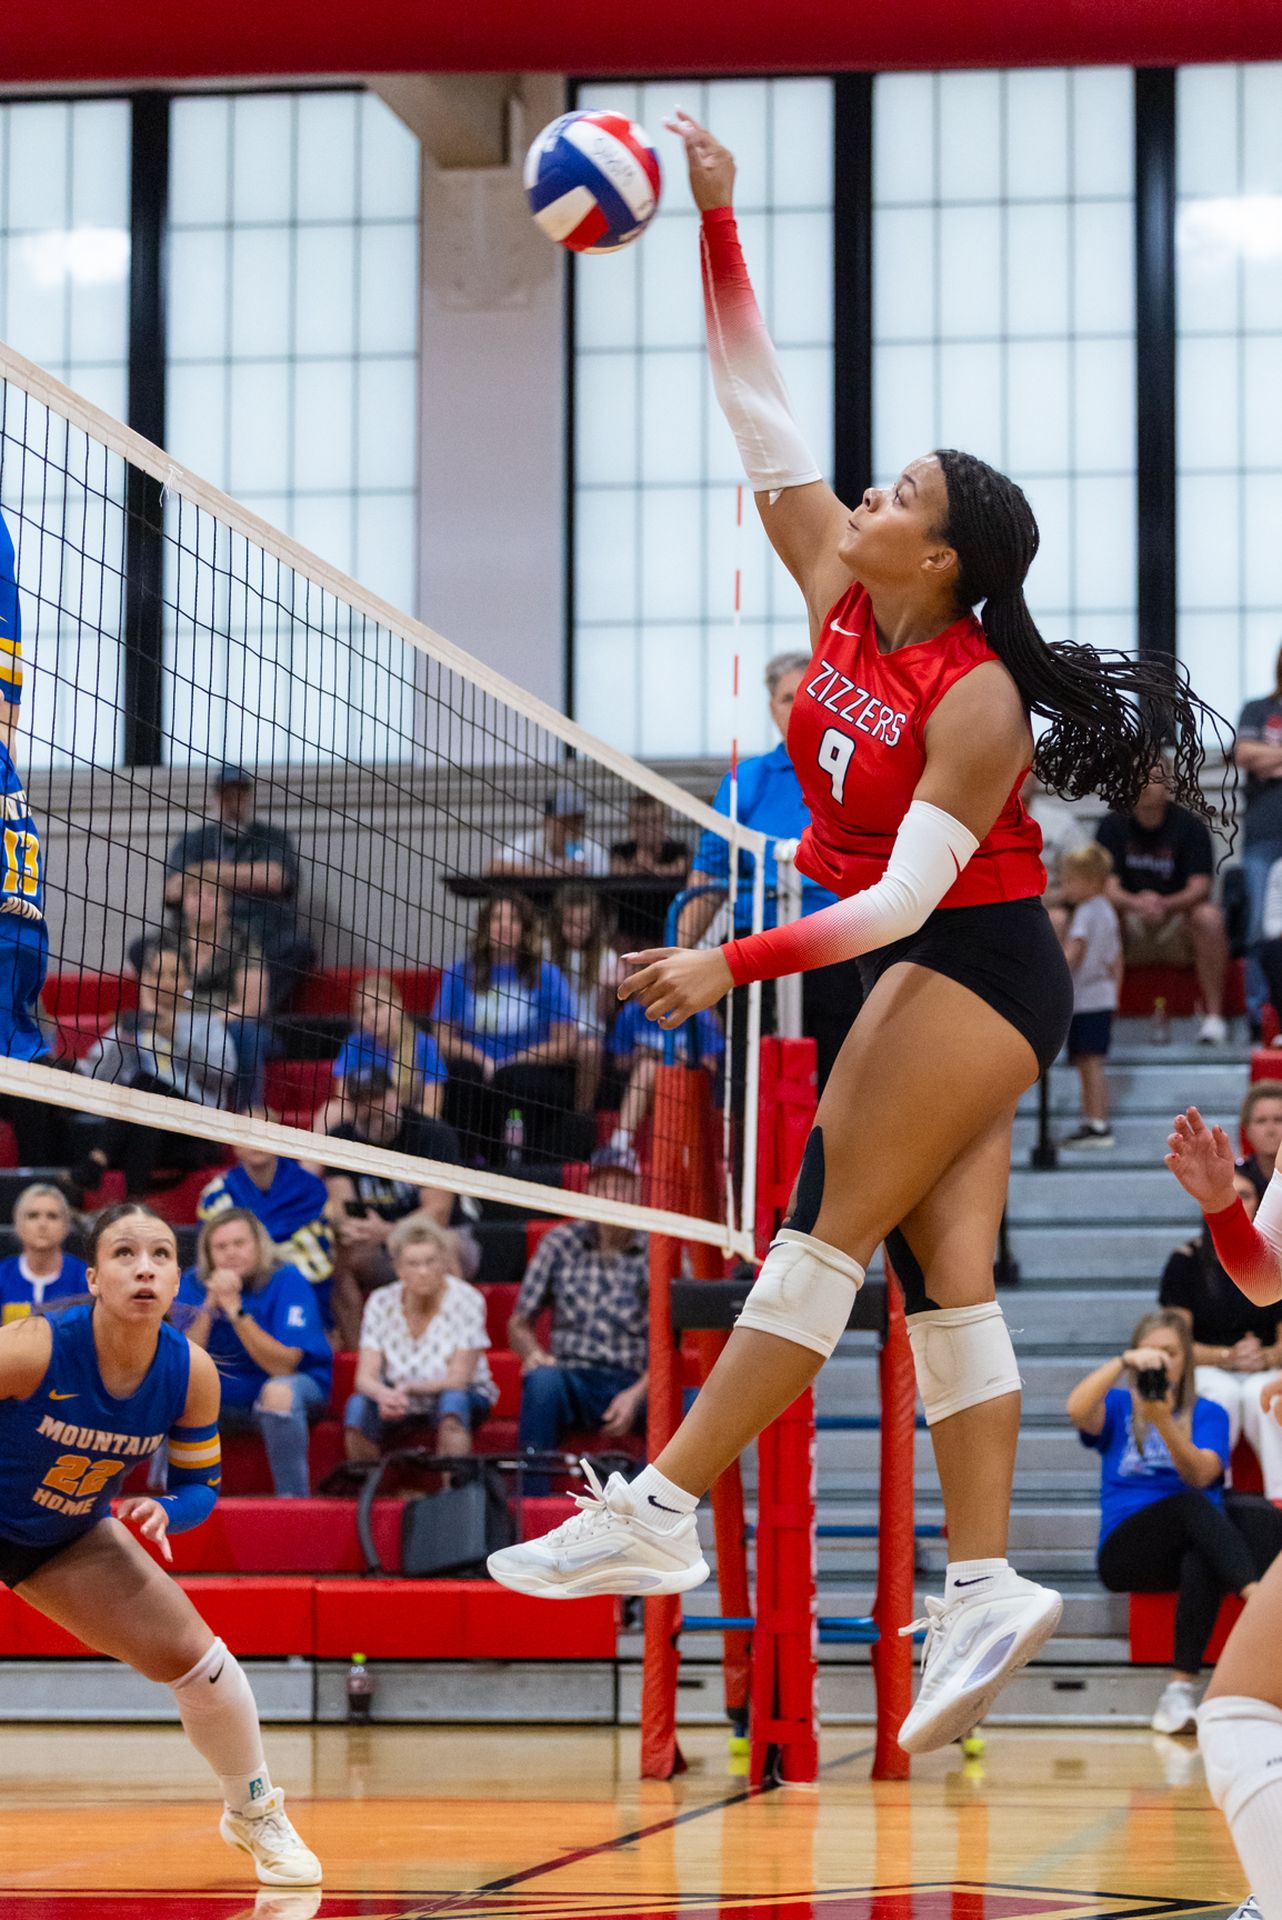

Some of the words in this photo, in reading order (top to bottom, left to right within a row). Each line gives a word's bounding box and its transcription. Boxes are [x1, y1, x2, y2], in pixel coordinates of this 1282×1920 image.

[806, 660, 906, 747] ZIZZERS
[818, 727, 856, 805] 9
[4, 828, 39, 895] 13
[33, 1488, 98, 1515] HOME
[43, 1454, 124, 1496] 22
